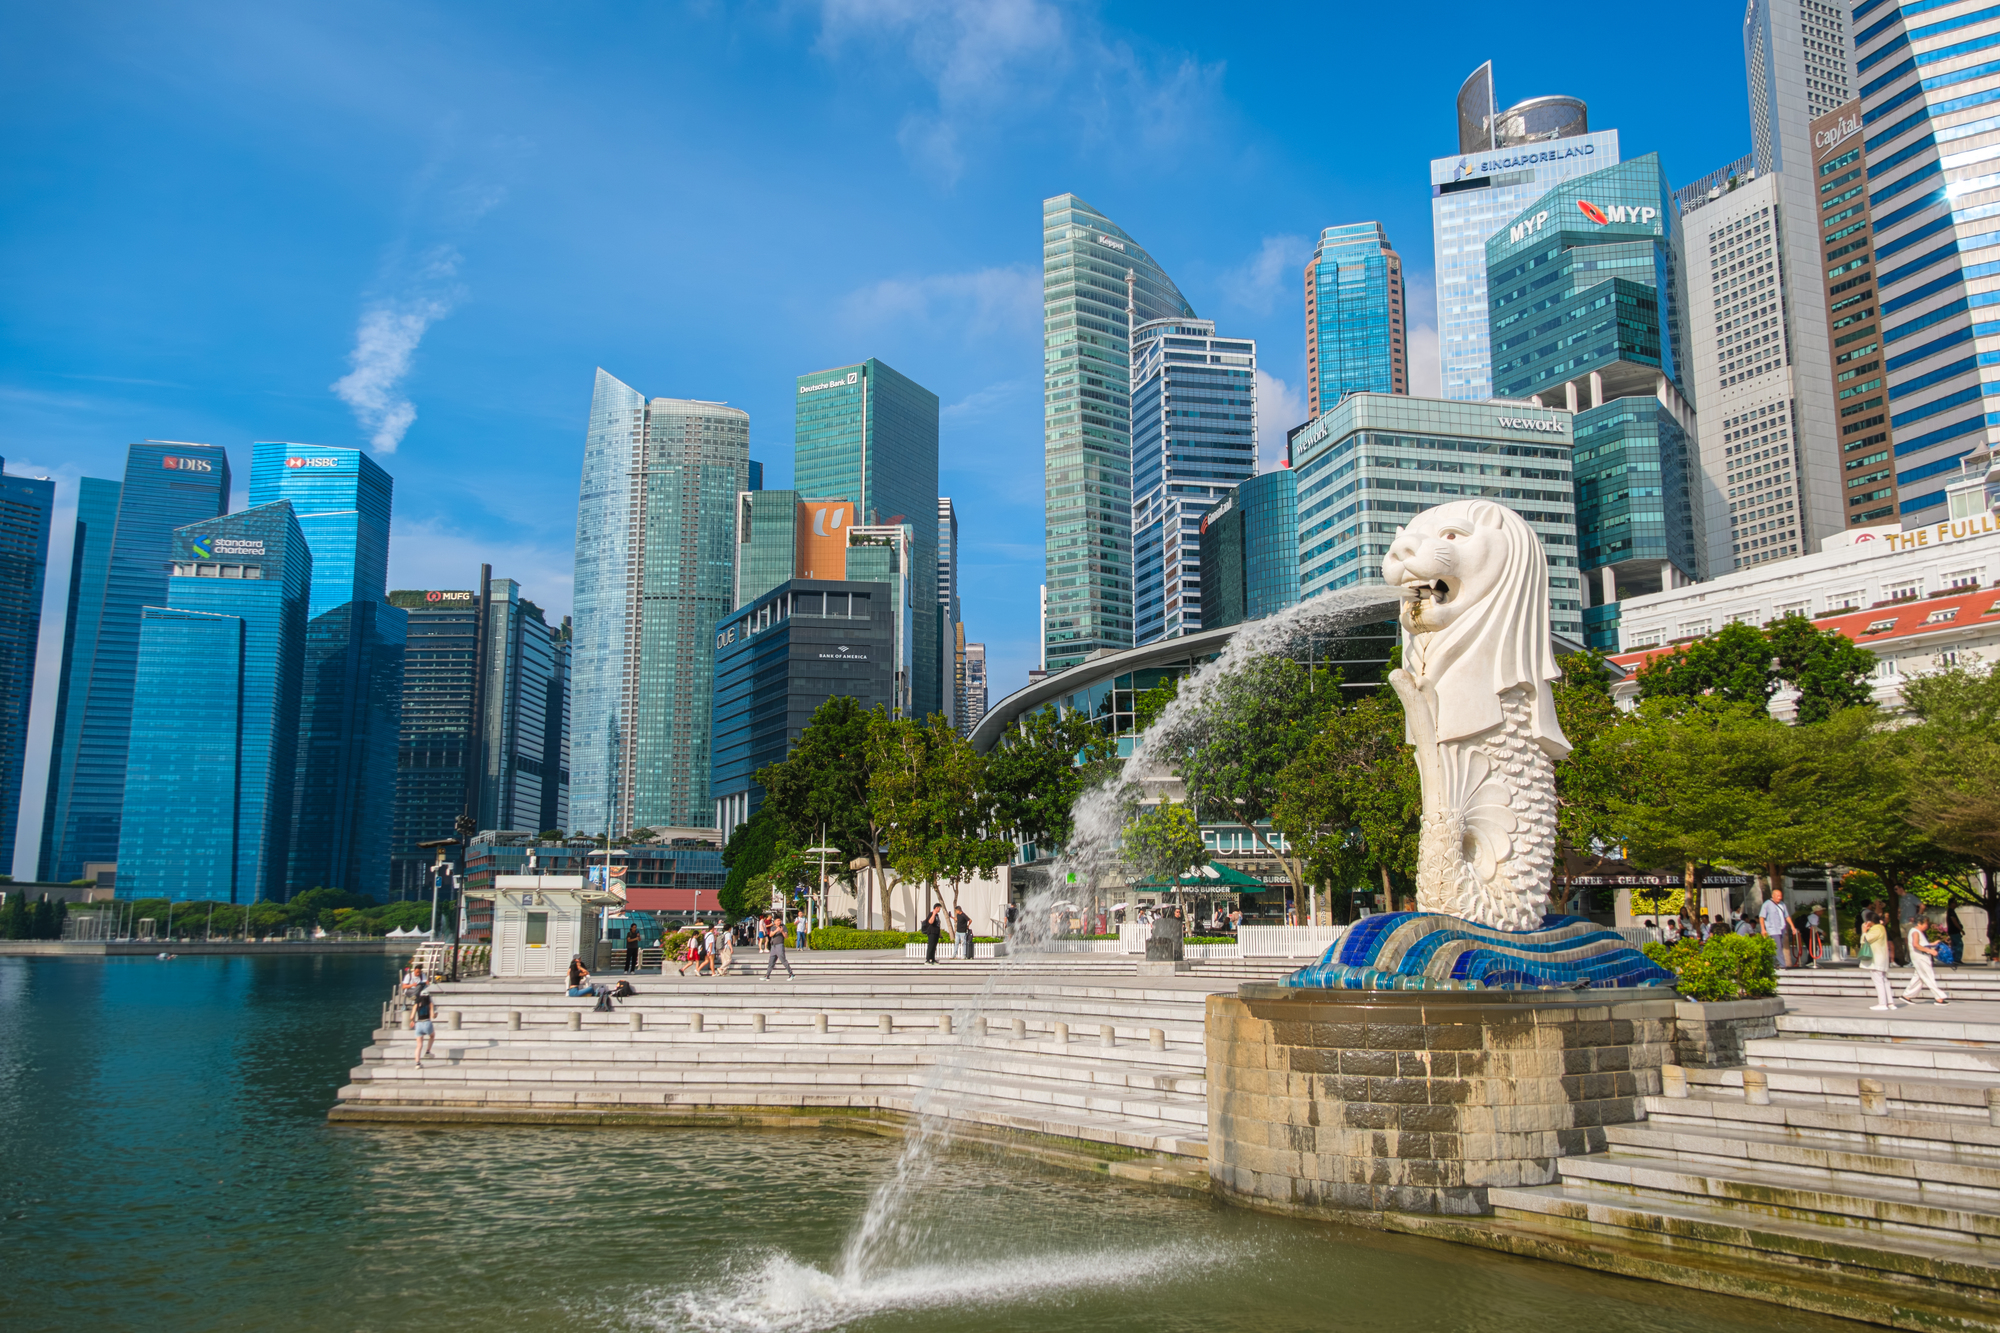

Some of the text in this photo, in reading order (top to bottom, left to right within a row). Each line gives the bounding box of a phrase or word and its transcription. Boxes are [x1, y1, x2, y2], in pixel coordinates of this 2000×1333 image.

[1815, 113, 1863, 148] CapitaL
[1480, 144, 1595, 171] SINGAPORELAND
[1608, 205, 1656, 224] MYP
[1510, 210, 1548, 244] MYP
[800, 379, 846, 394] Deutsche Bank
[1497, 415, 1565, 432] wework
[1297, 420, 1328, 455] wework
[179, 458, 211, 472] DBS
[306, 458, 338, 467] HSBC
[215, 538, 263, 548] standard
[1885, 529, 1928, 552] THE
[214, 546, 265, 556] chartered
[442, 592, 470, 600] MUFG
[716, 627, 736, 650] OUE
[1263, 875, 1291, 883] BURGE
[1618, 876, 1660, 885] GELATO
